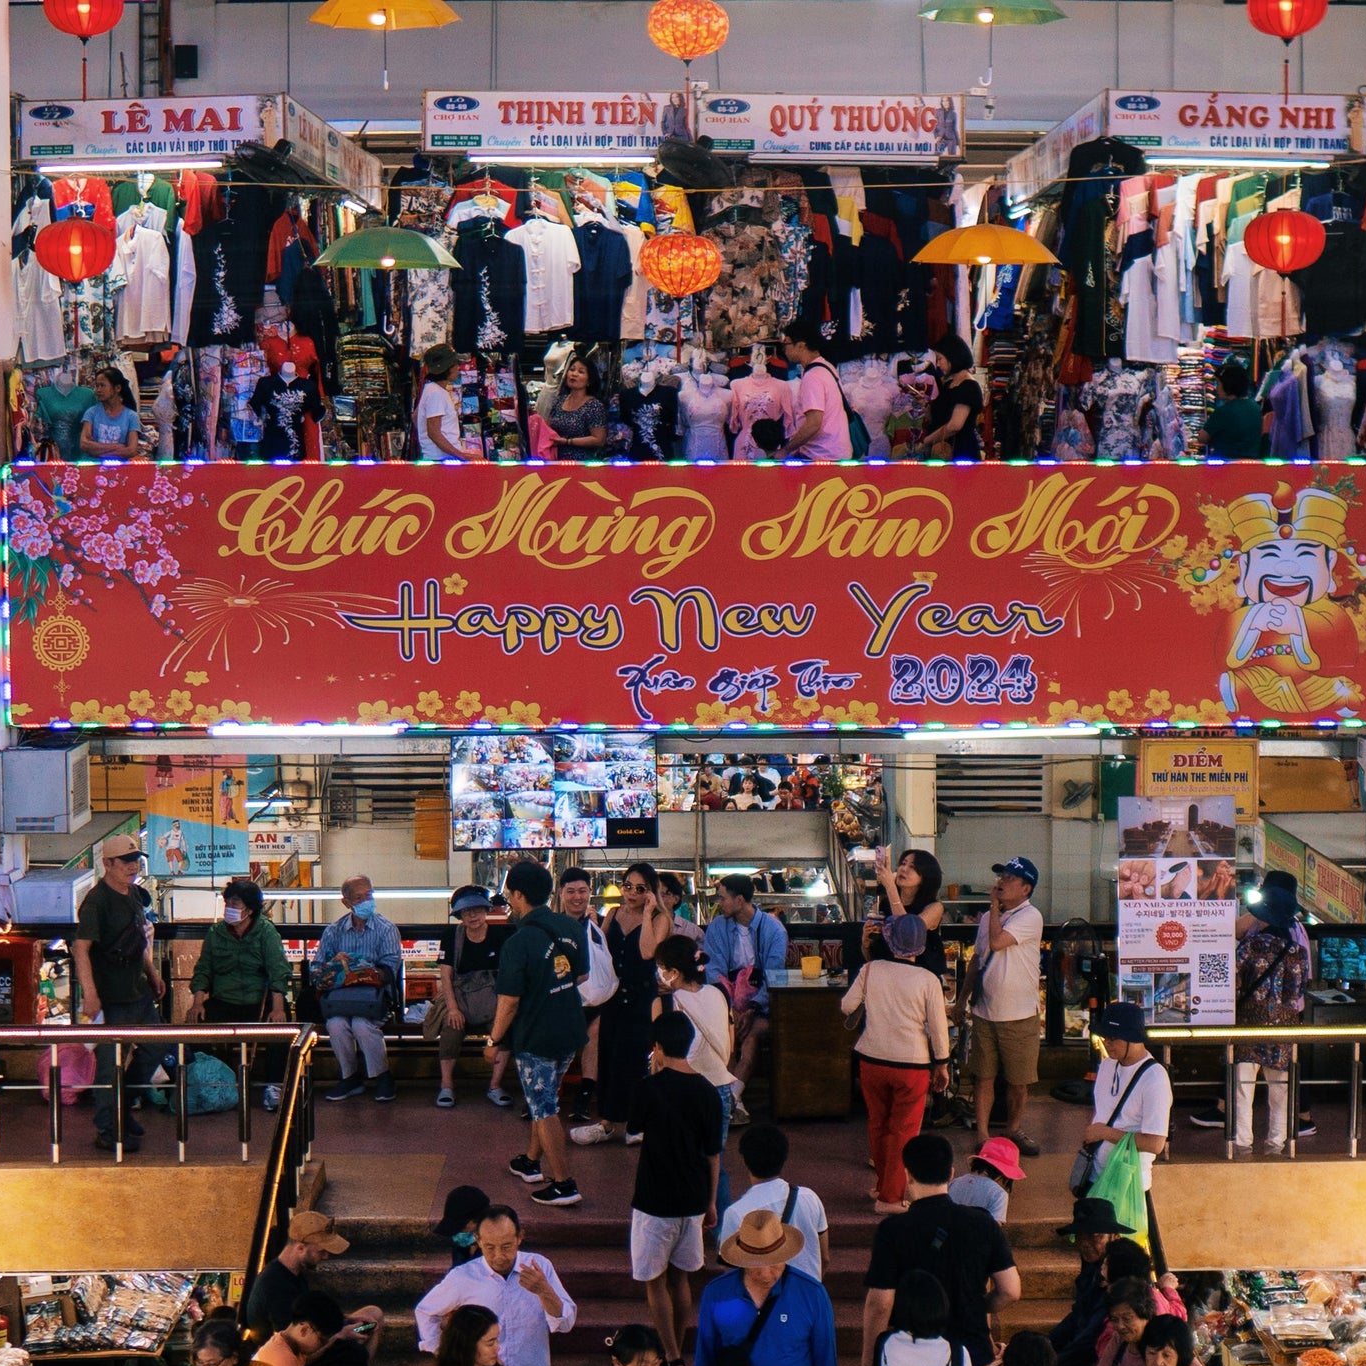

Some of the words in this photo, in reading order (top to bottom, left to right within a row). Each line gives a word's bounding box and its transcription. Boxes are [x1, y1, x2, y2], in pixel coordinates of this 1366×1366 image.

[101, 103, 151, 134] LÊ
[163, 106, 244, 133] MAI
[498, 100, 585, 130] THỊNH
[591, 95, 657, 125] TIÊN
[769, 103, 824, 132] QUÝ
[831, 104, 936, 133] THƯƠNG
[1279, 106, 1336, 130] NHI
[1210, 135, 1229, 149] CÁC
[218, 475, 434, 572] Chúc
[444, 470, 715, 581] Mừng
[742, 477, 954, 561] Năm
[971, 470, 1182, 570] Mới
[339, 577, 626, 665] Happy
[629, 585, 816, 654] New
[848, 578, 1065, 659] Year
[618, 654, 696, 722] Xuân
[708, 667, 780, 714] Giáp
[789, 658, 854, 704] Thìn
[890, 653, 1038, 706] 2024
[1173, 747, 1223, 767] ĐIỂM
[1152, 769, 1169, 783] THỬ
[1170, 770, 1189, 783] HÀN
[1191, 773, 1207, 783] THE
[1209, 769, 1231, 783] MIỄN
[1234, 768, 1249, 783] PHÍ
